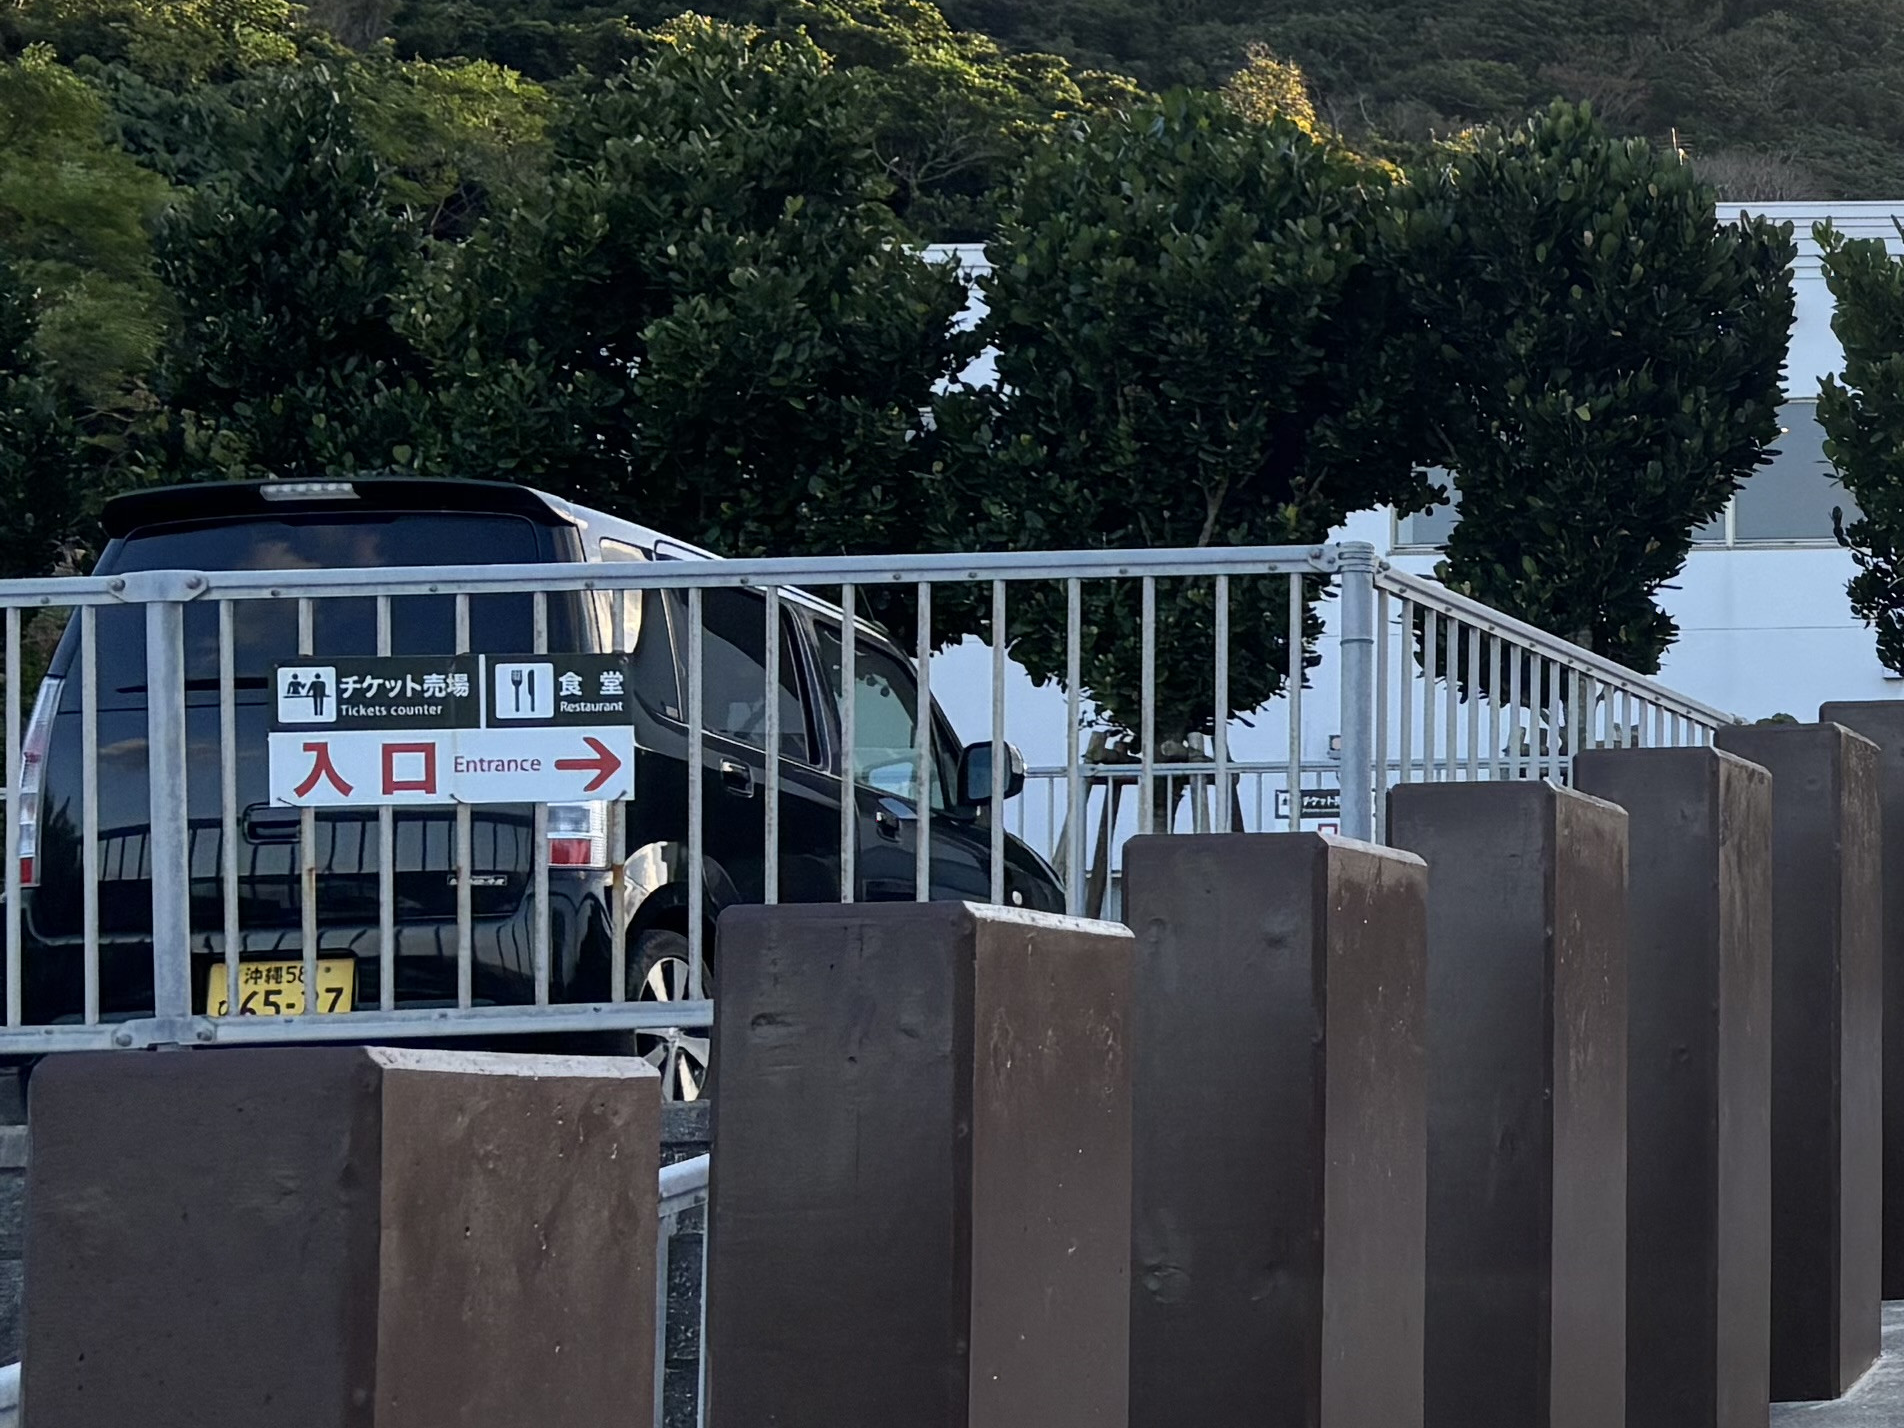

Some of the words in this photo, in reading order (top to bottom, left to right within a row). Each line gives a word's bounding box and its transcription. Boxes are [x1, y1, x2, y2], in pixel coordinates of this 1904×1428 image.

[339, 673, 470, 699] チケット売場
[558, 670, 624, 697] 食堂
[340, 704, 387, 717] Tickets
[390, 703, 443, 716] counter
[559, 700, 623, 713] Restaurant
[293, 741, 437, 798] 入口
[453, 756, 542, 773] Entrance
